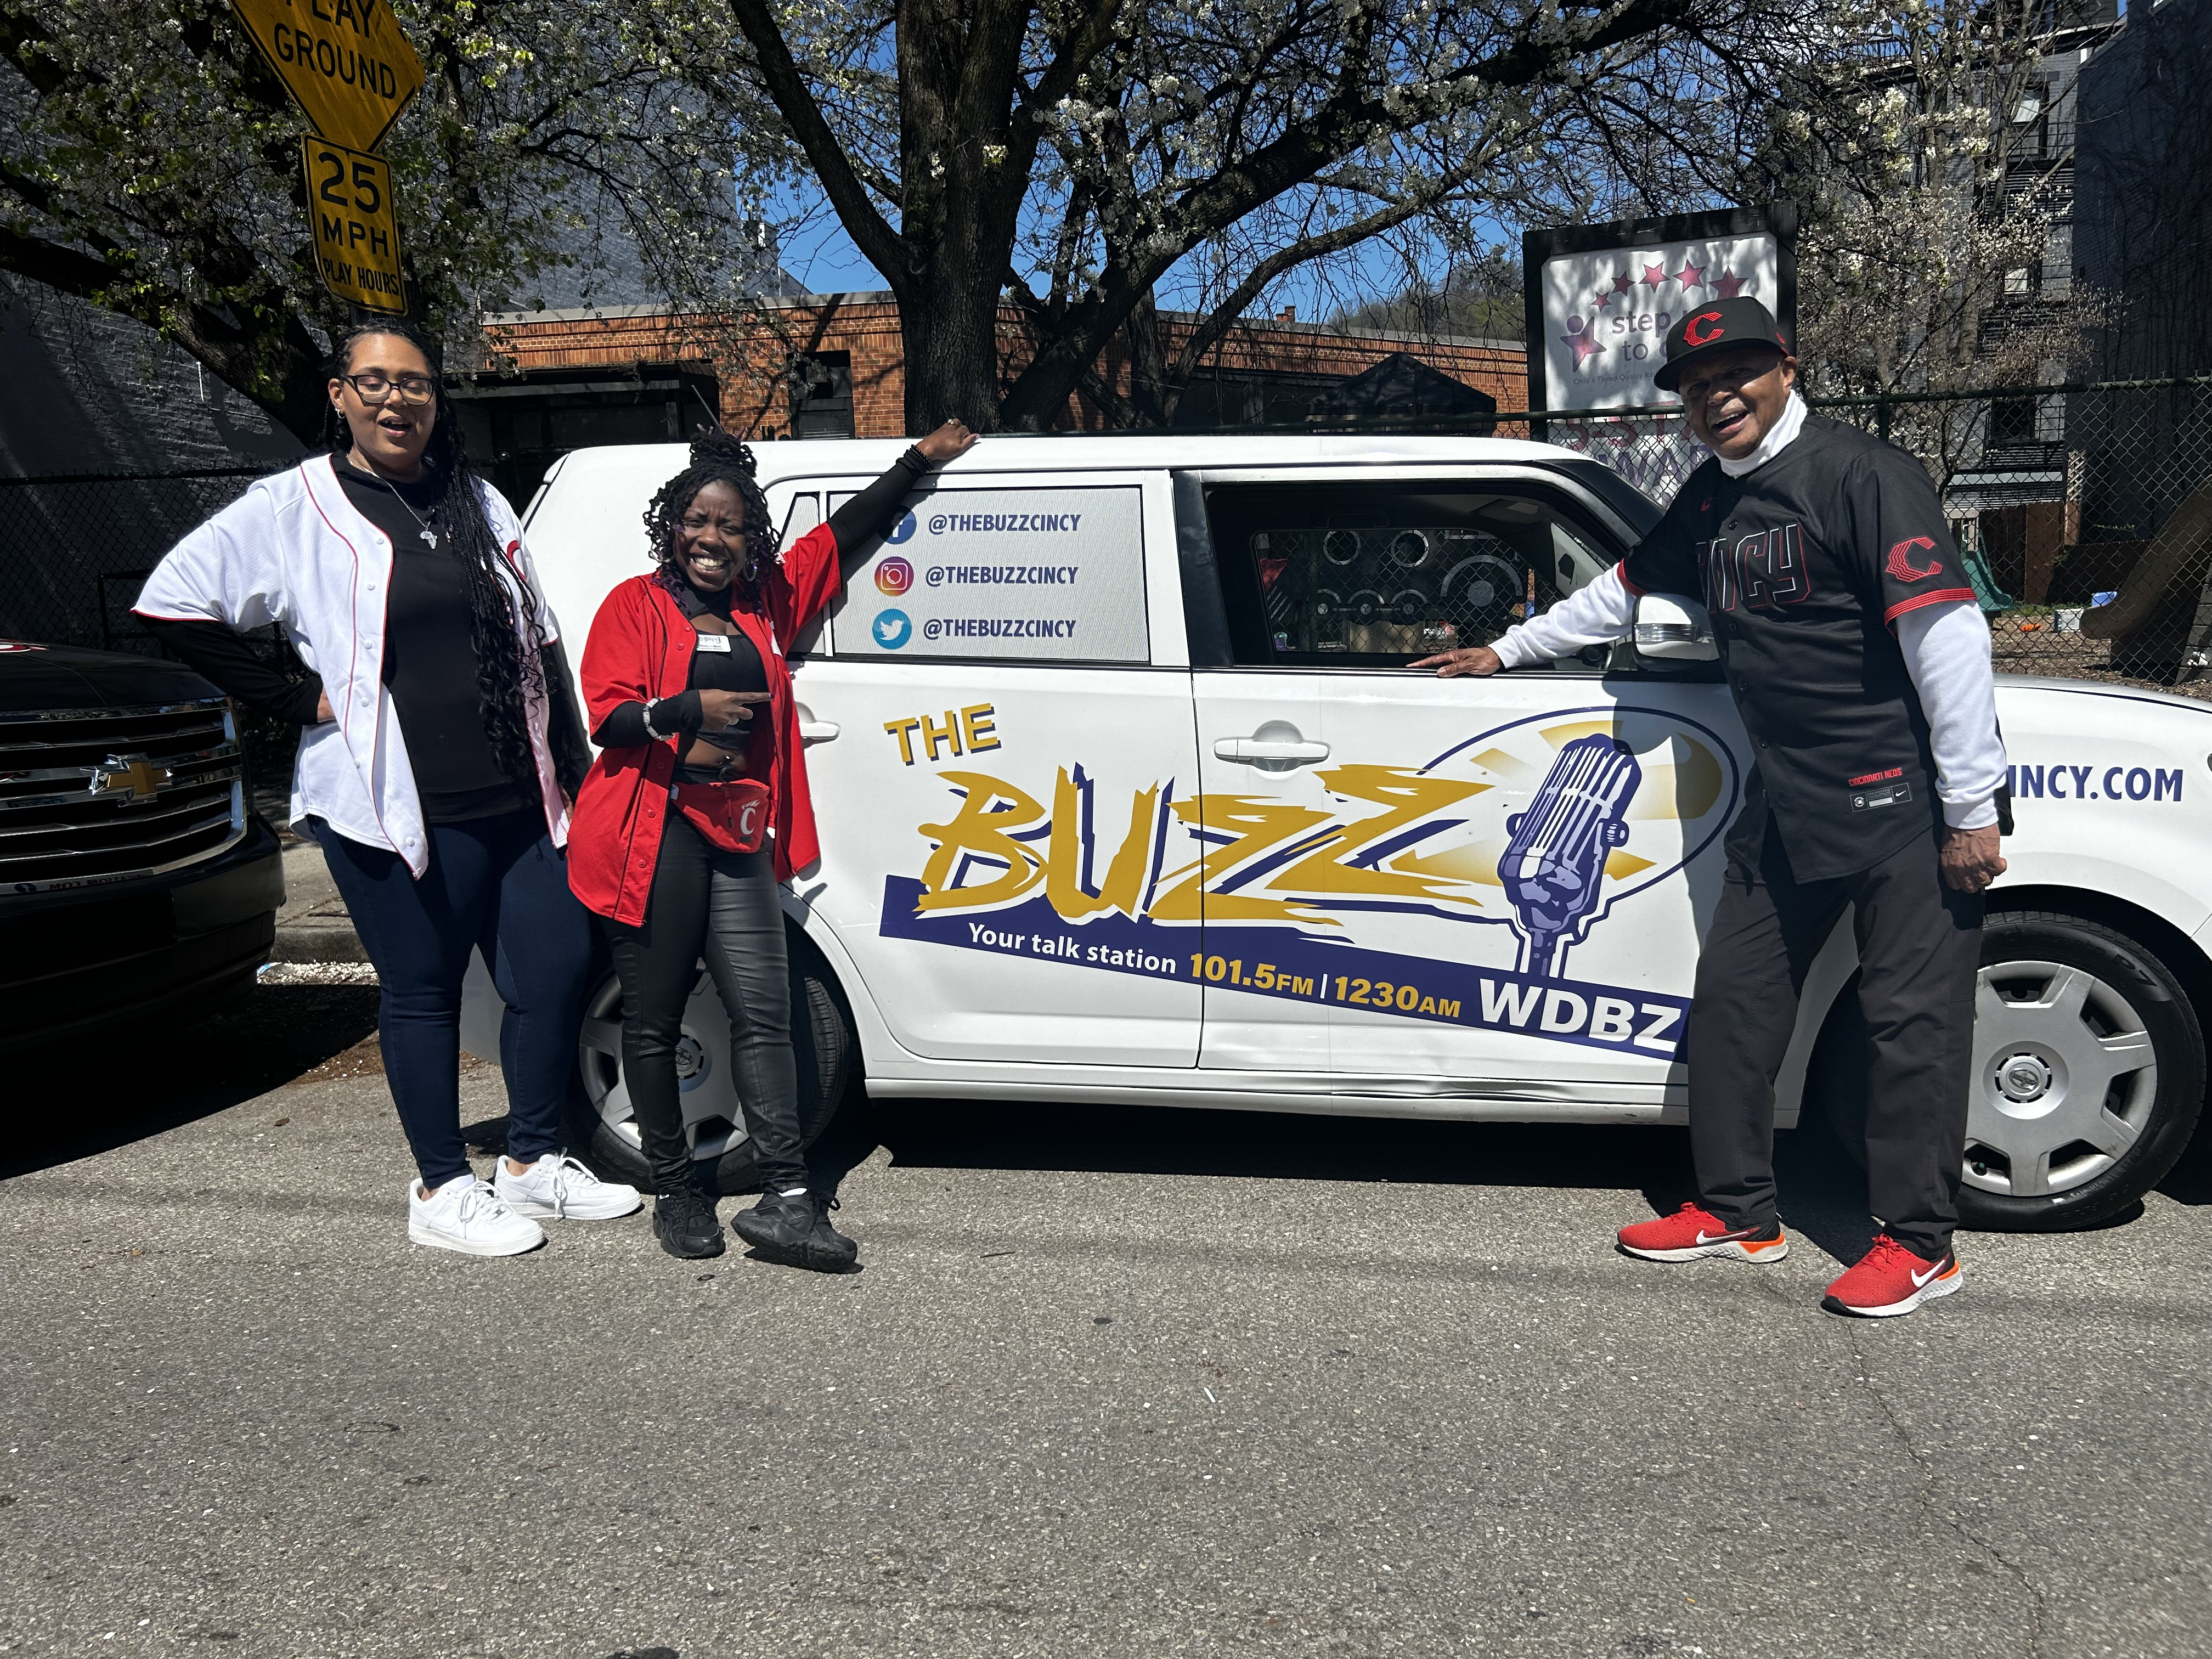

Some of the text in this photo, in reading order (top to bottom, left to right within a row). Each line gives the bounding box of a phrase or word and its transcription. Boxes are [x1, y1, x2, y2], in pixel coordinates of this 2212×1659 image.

[286, 0, 375, 38] LAY
[274, 22, 397, 99] GROUND
[318, 151, 381, 214] 25
[323, 213, 389, 258] MPH
[324, 257, 399, 296] PLAY HOURS
[1612, 310, 1671, 338] step
[1683, 311, 1725, 347] C
[1622, 341, 1649, 362] to
[1573, 377, 1595, 385] Ohio's
[1619, 373, 1643, 381] Quality
[928, 514, 1081, 535] @THEBUZZCINCY
[926, 566, 1079, 588] @THEBUZZCINCY
[1885, 535, 1943, 583] C
[923, 619, 1076, 641] @THEBUZZCINCY
[883, 702, 1002, 766] THE
[2007, 765, 2183, 802] INCY.COM
[912, 762, 1496, 927] BUZZ
[968, 922, 1461, 1019] Your talk station 101.5FM 1230AM
[1480, 978, 1682, 1053] WDBZ
